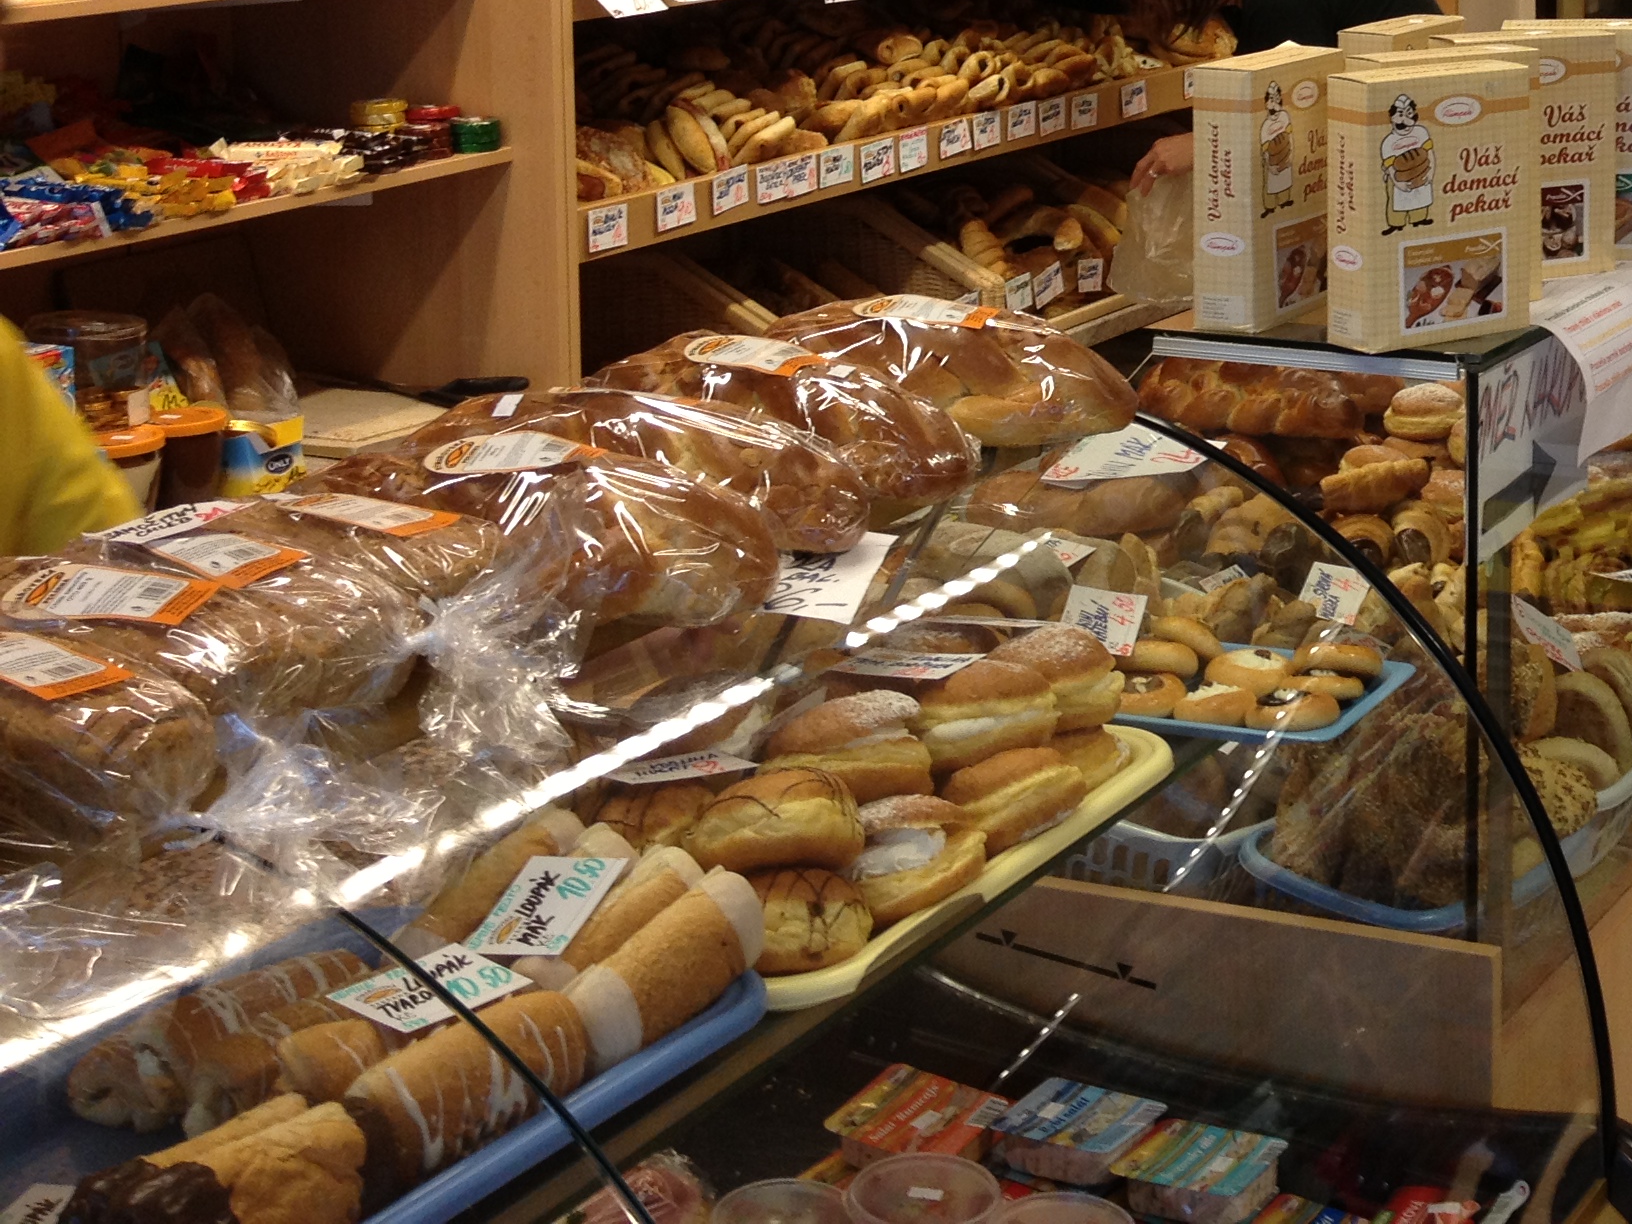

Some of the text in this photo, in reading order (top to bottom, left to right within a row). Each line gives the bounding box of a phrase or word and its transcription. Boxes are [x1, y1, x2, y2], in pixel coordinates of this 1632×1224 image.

[1544, 104, 1586, 128] Váš
[1308, 129, 1327, 153] Vá
[1540, 123, 1605, 145] omácí
[1459, 145, 1503, 173] Váš
[1303, 179, 1327, 203] pek
[1442, 167, 1520, 195] domácí
[1450, 189, 1512, 223] pekař
[267, 458, 291, 471] ONLY
[514, 870, 562, 918] LOUPÁK
[516, 914, 556, 947] MÁK
[402, 954, 473, 992] LPÁK
[377, 989, 436, 1021] TVARO
